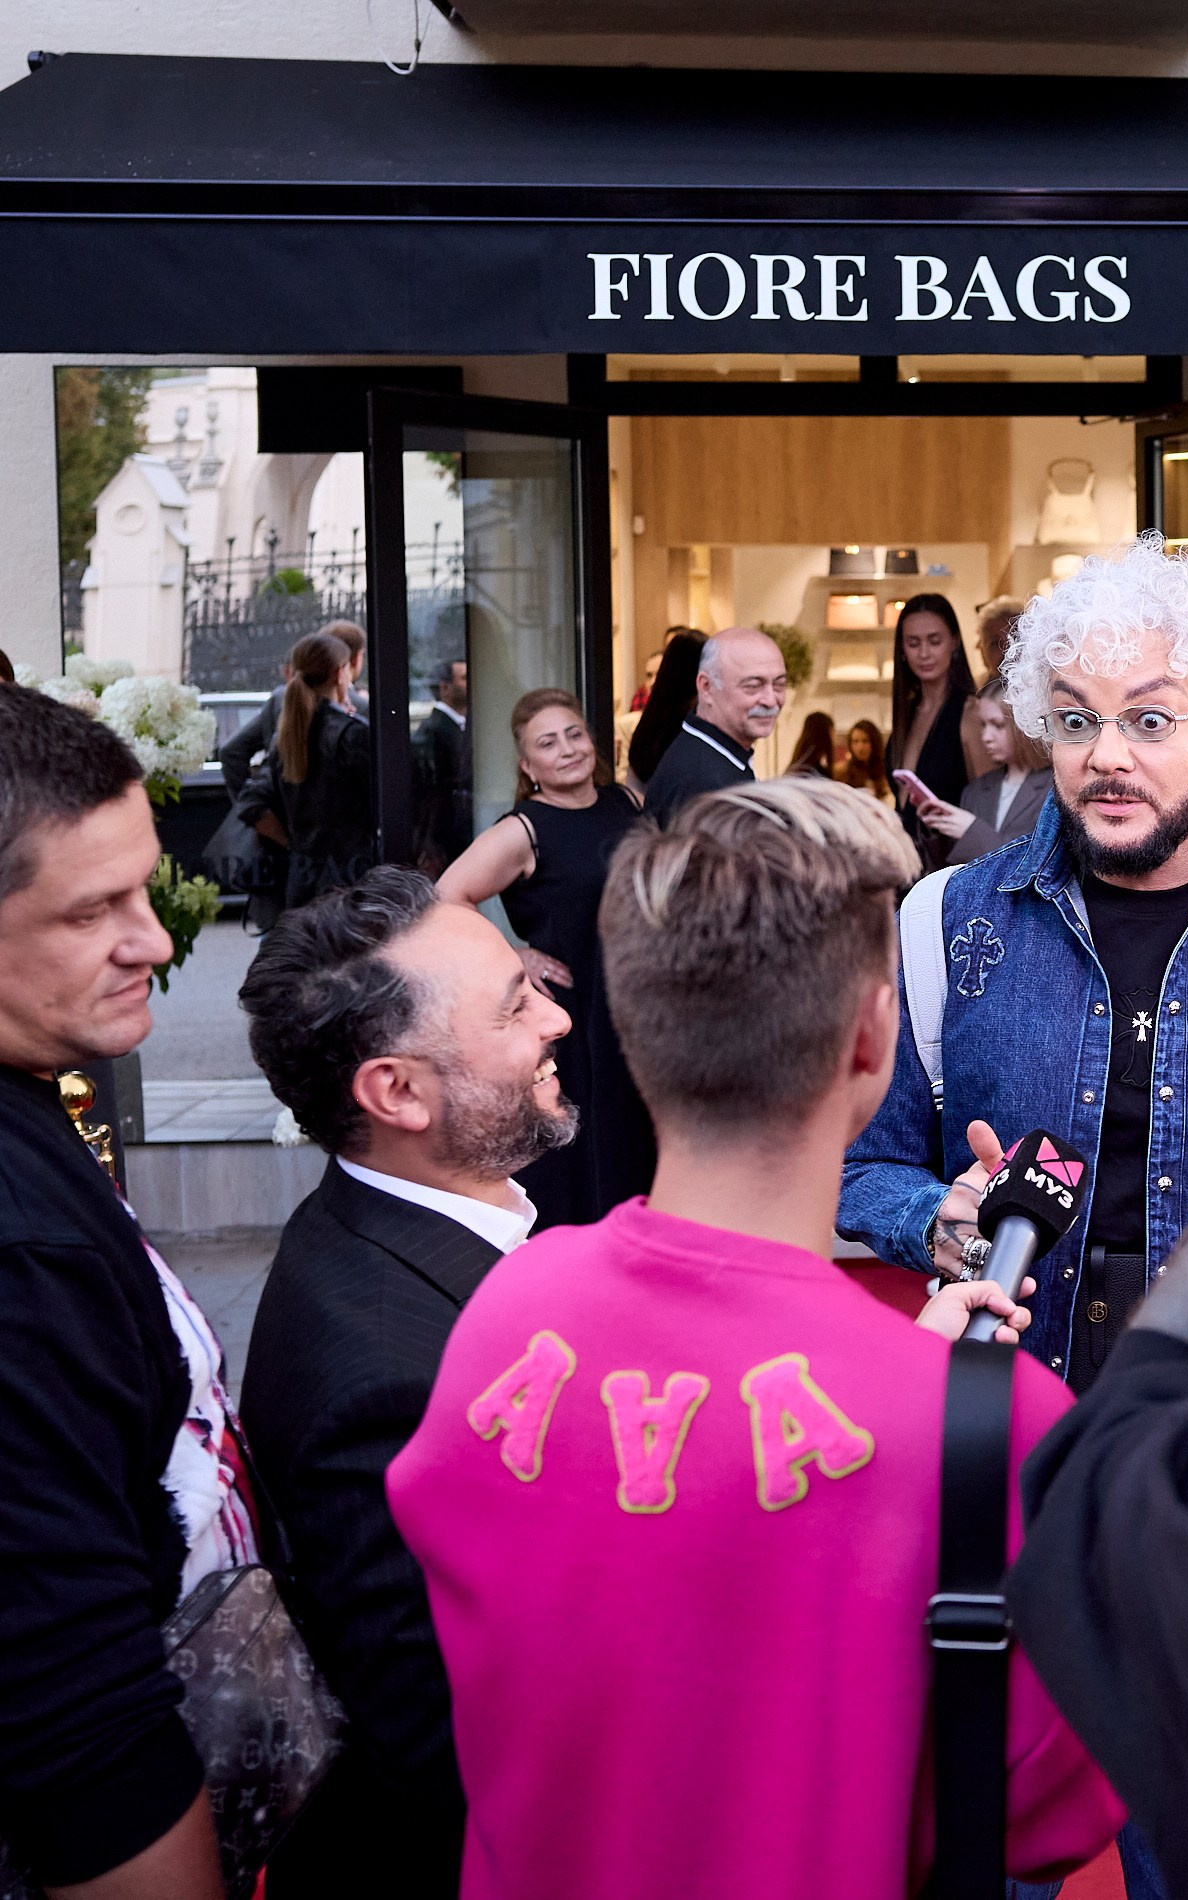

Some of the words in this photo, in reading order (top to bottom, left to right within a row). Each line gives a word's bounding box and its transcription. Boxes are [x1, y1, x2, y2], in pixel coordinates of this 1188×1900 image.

[586, 252, 869, 323] FIORE
[894, 254, 1132, 323] BAGS
[1024, 1166, 1074, 1209] МУЗ
